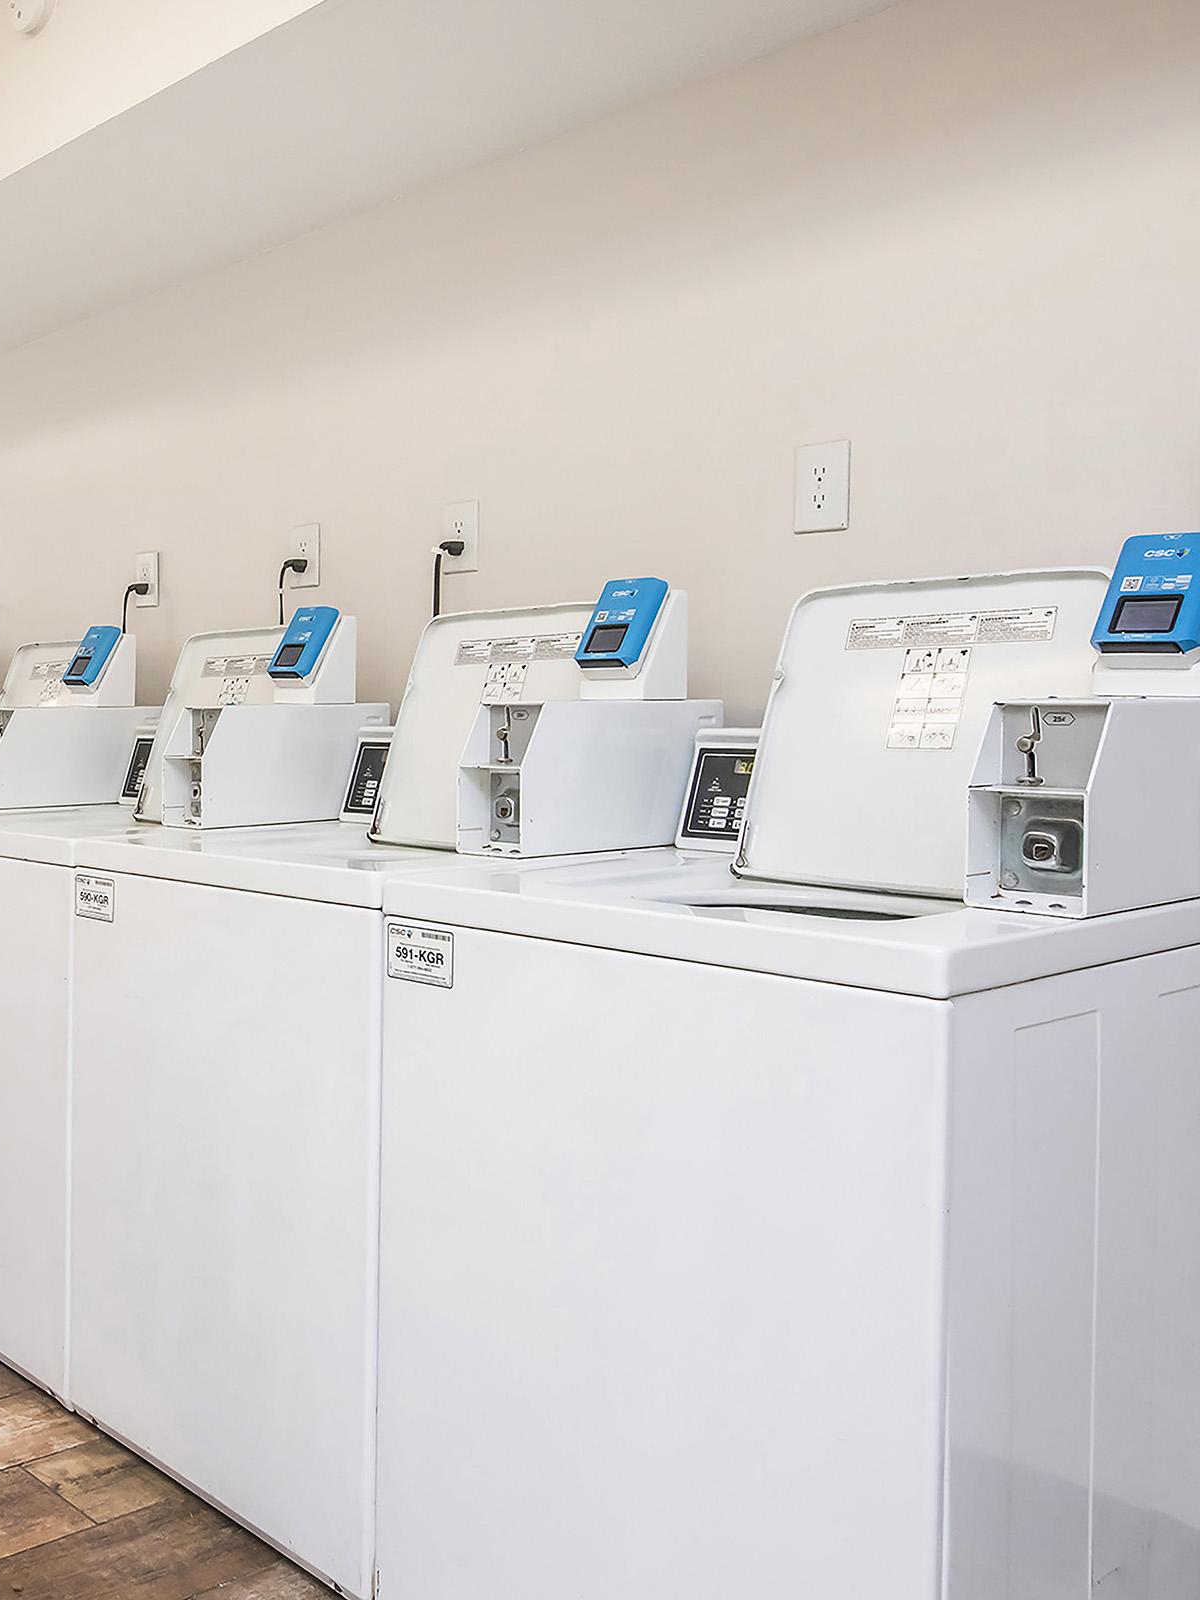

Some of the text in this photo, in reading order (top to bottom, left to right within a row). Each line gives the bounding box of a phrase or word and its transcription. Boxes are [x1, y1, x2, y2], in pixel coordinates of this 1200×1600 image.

[1143, 549, 1176, 559] CSC
[79, 891, 109, 905] 590-KGR
[390, 927, 406, 935] CSC
[395, 946, 444, 965] 591-KGR
